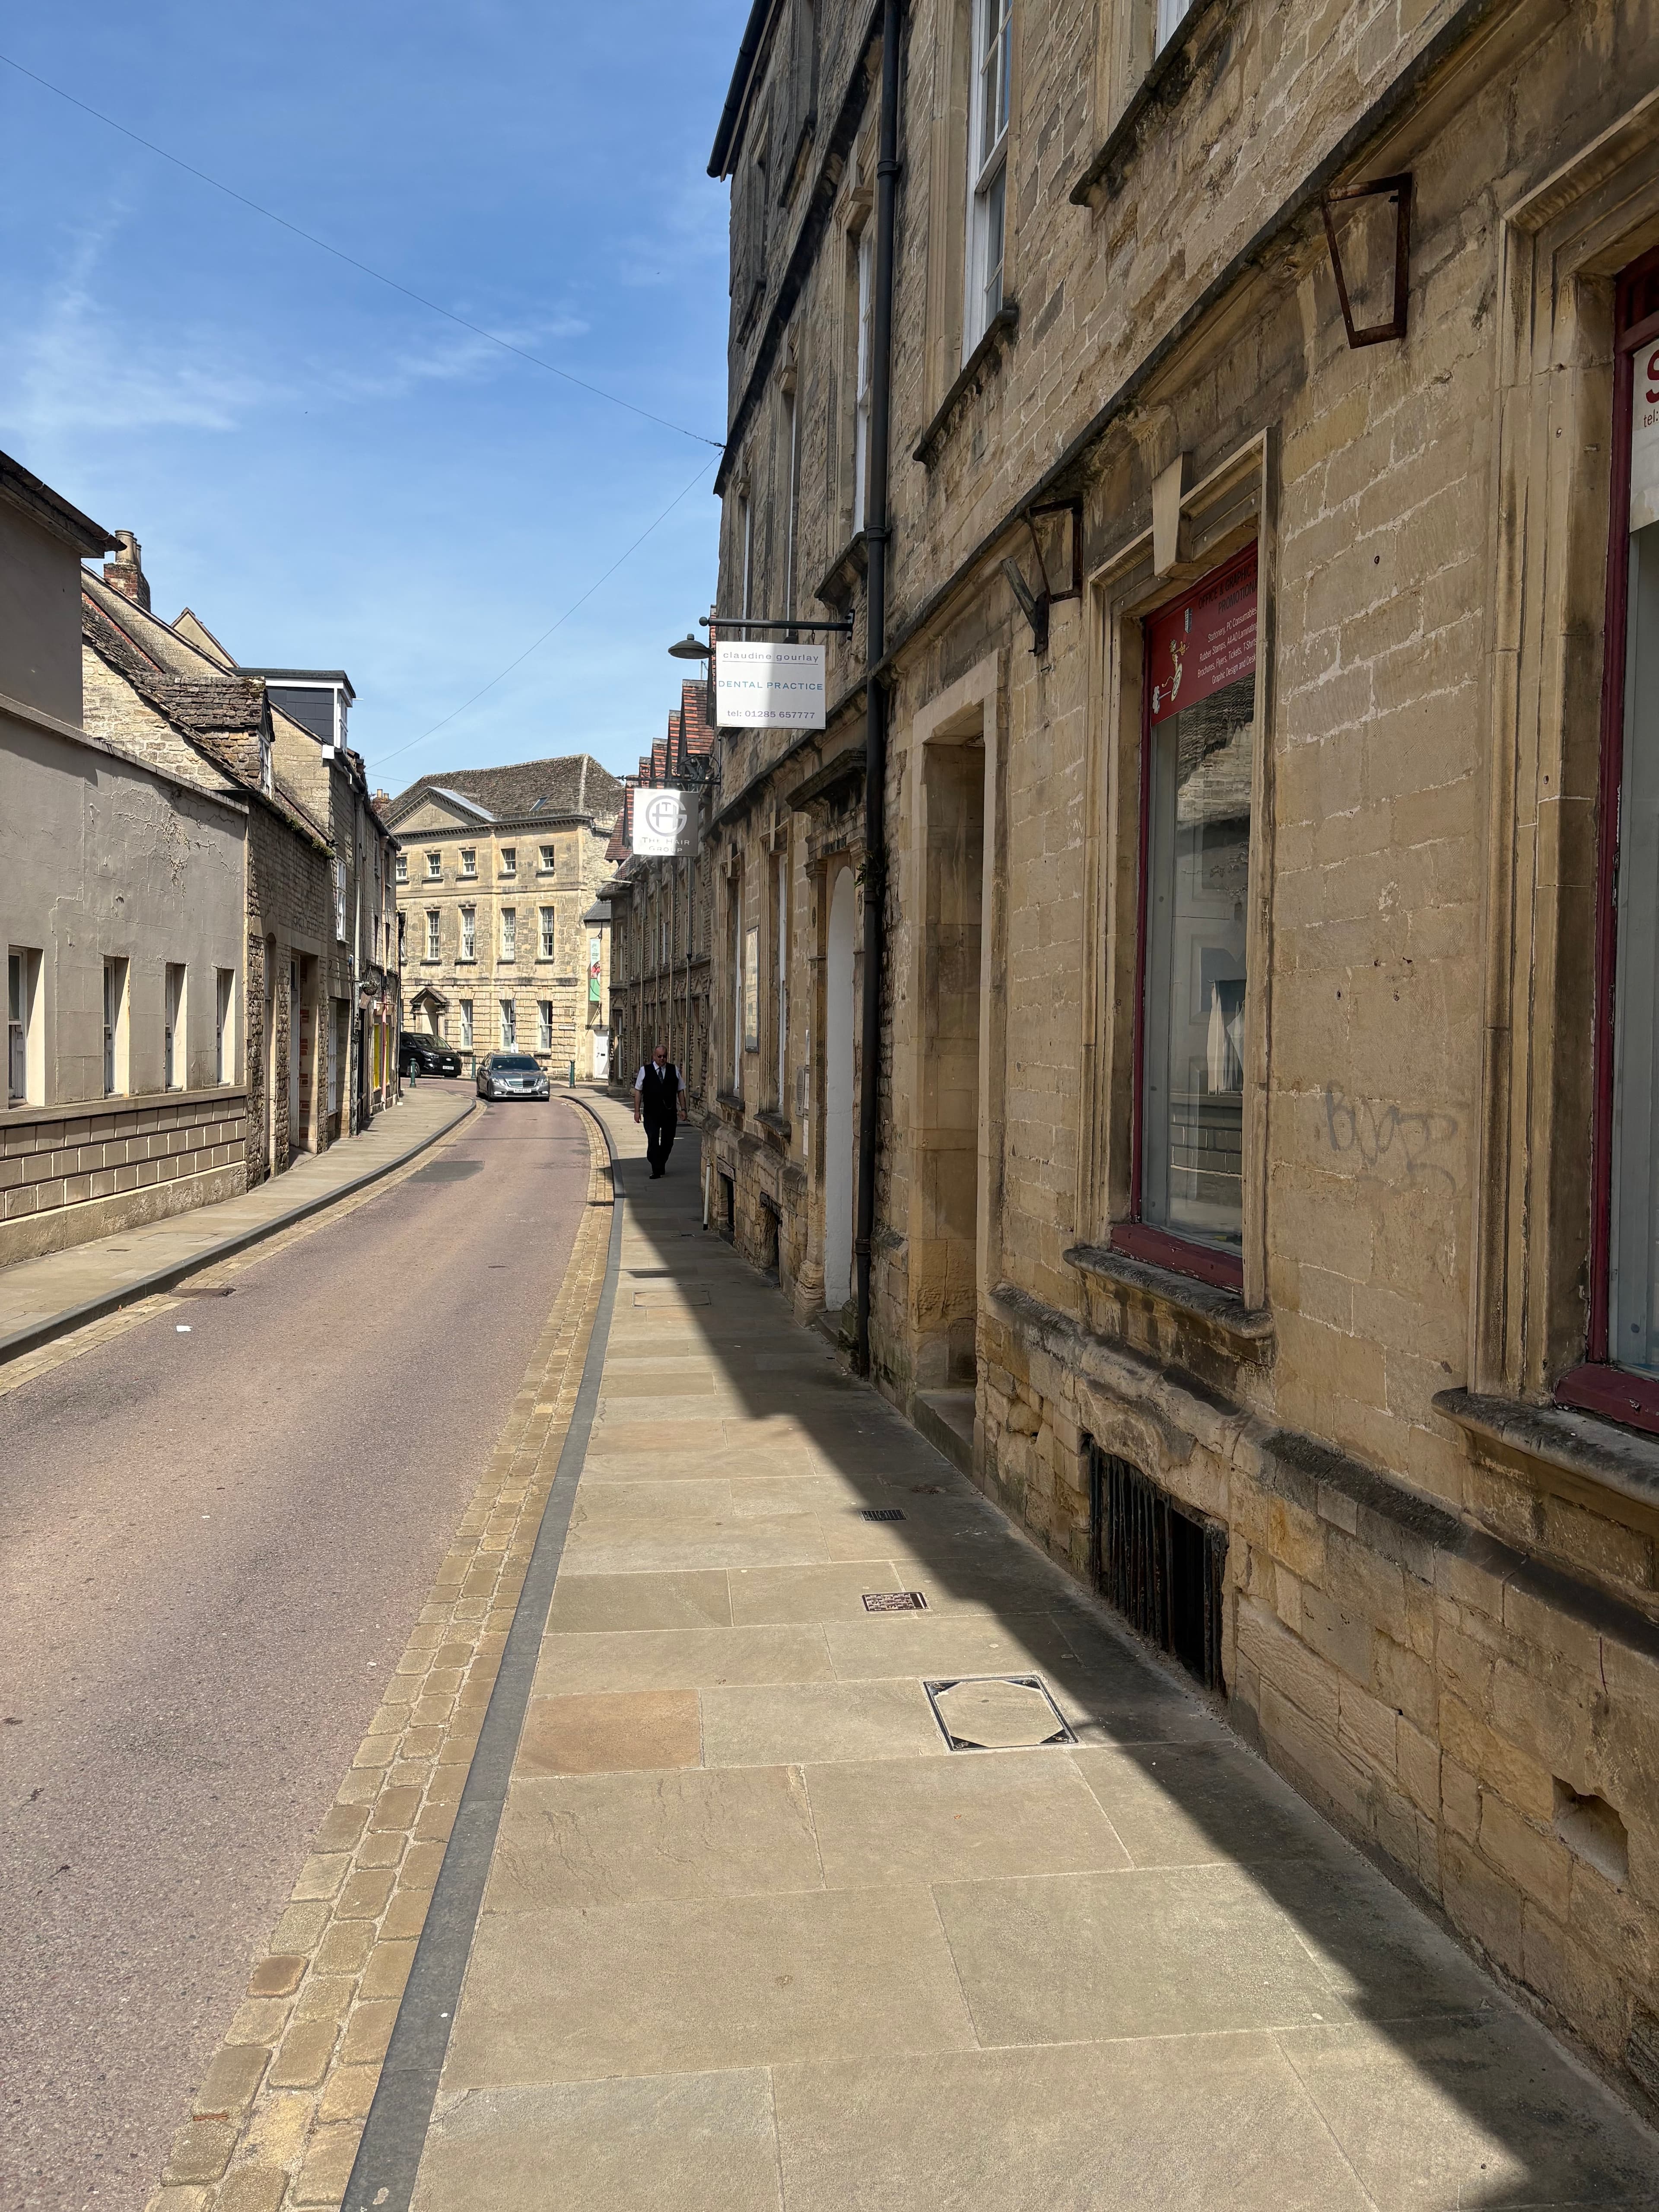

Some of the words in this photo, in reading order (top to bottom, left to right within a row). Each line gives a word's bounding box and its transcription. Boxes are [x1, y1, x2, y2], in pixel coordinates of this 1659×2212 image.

[1643, 409, 1659, 428] tel:
[1198, 588, 1218, 609] OFFICE
[1220, 582, 1224, 596] &
[1225, 565, 1251, 591] GRAPHIC
[1227, 620, 1232, 631] PC
[1233, 607, 1257, 627] Consumables
[1199, 649, 1212, 662] Rubber
[1212, 642, 1226, 655] Stamps,
[1238, 622, 1258, 640] Laminating
[723, 652, 772, 660] claudine
[776, 654, 819, 663] gourlay
[1198, 663, 1216, 678] Brochures,
[1216, 655, 1227, 668] Flyers,
[1228, 647, 1242, 661] Tickets,
[1212, 671, 1226, 684] Graphic
[1226, 663, 1238, 677] Design
